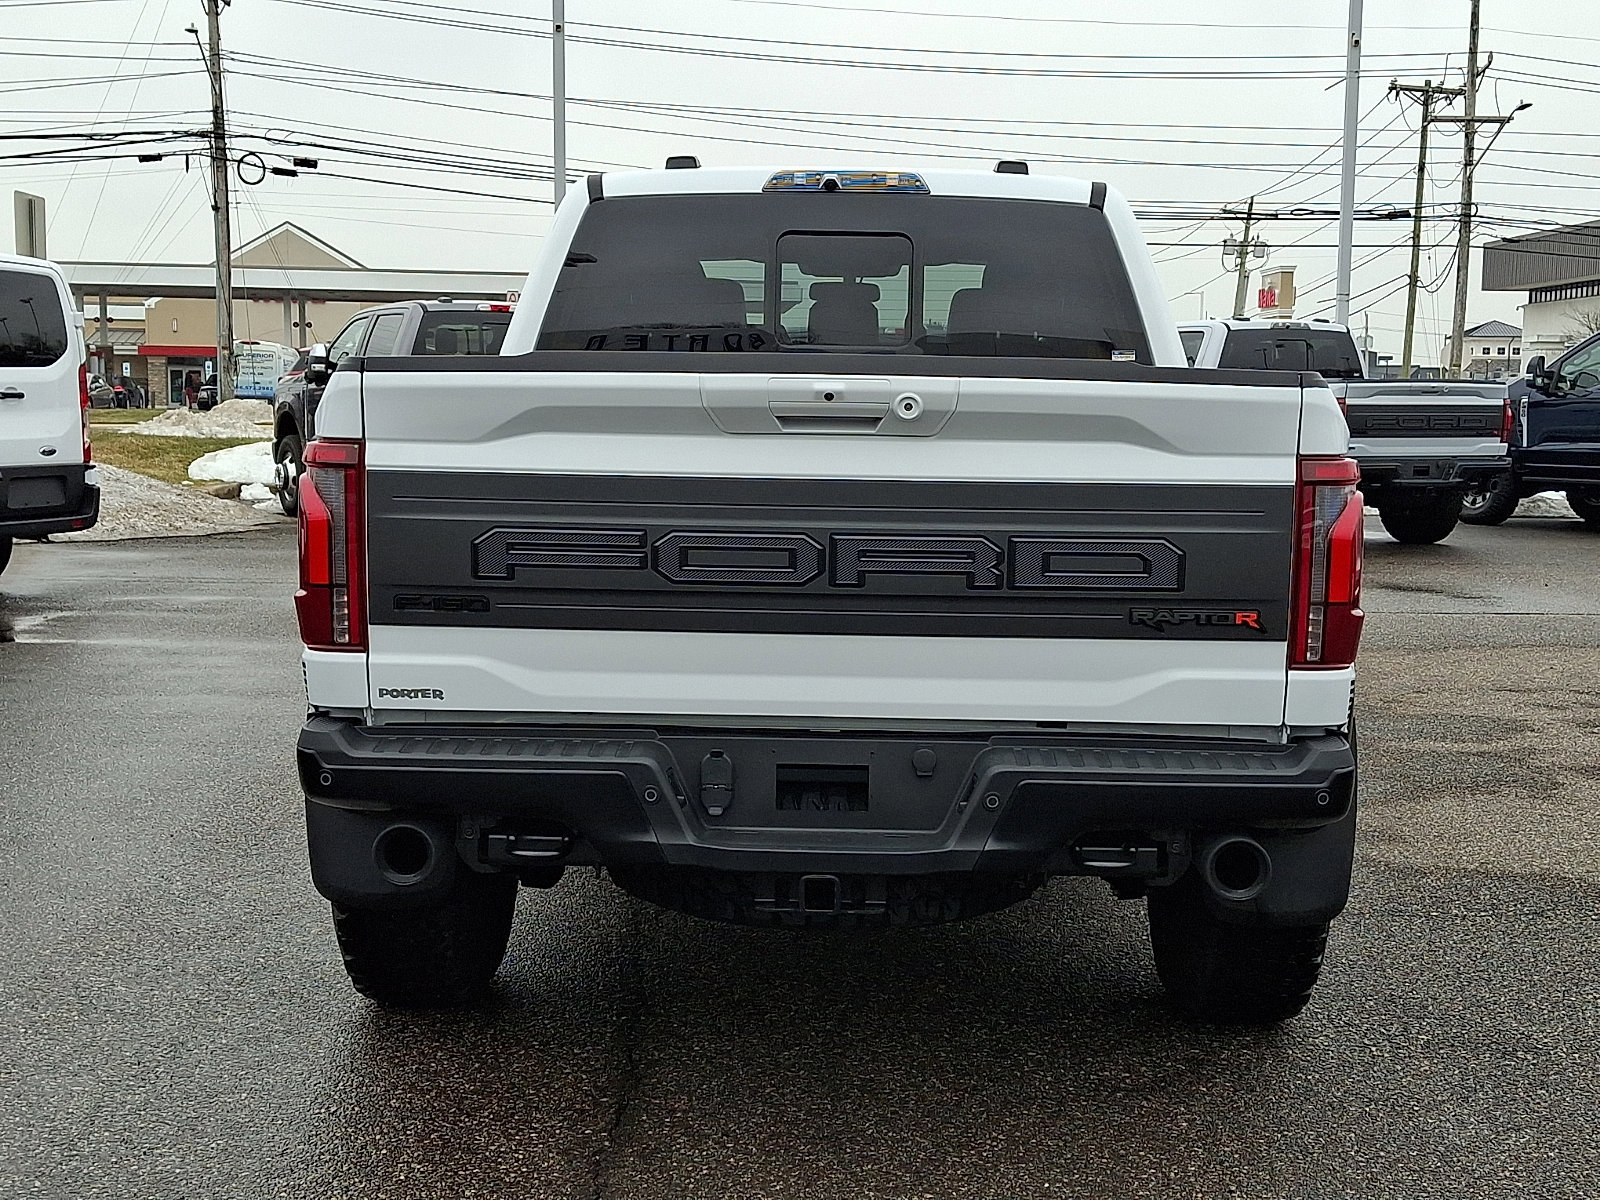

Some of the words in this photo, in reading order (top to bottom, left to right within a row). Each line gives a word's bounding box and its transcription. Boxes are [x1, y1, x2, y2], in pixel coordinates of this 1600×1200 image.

[1365, 415, 1488, 428] FORD
[471, 526, 1187, 592] FORD
[1129, 608, 1267, 634] RAPTOR
[378, 687, 445, 700] PORTER
